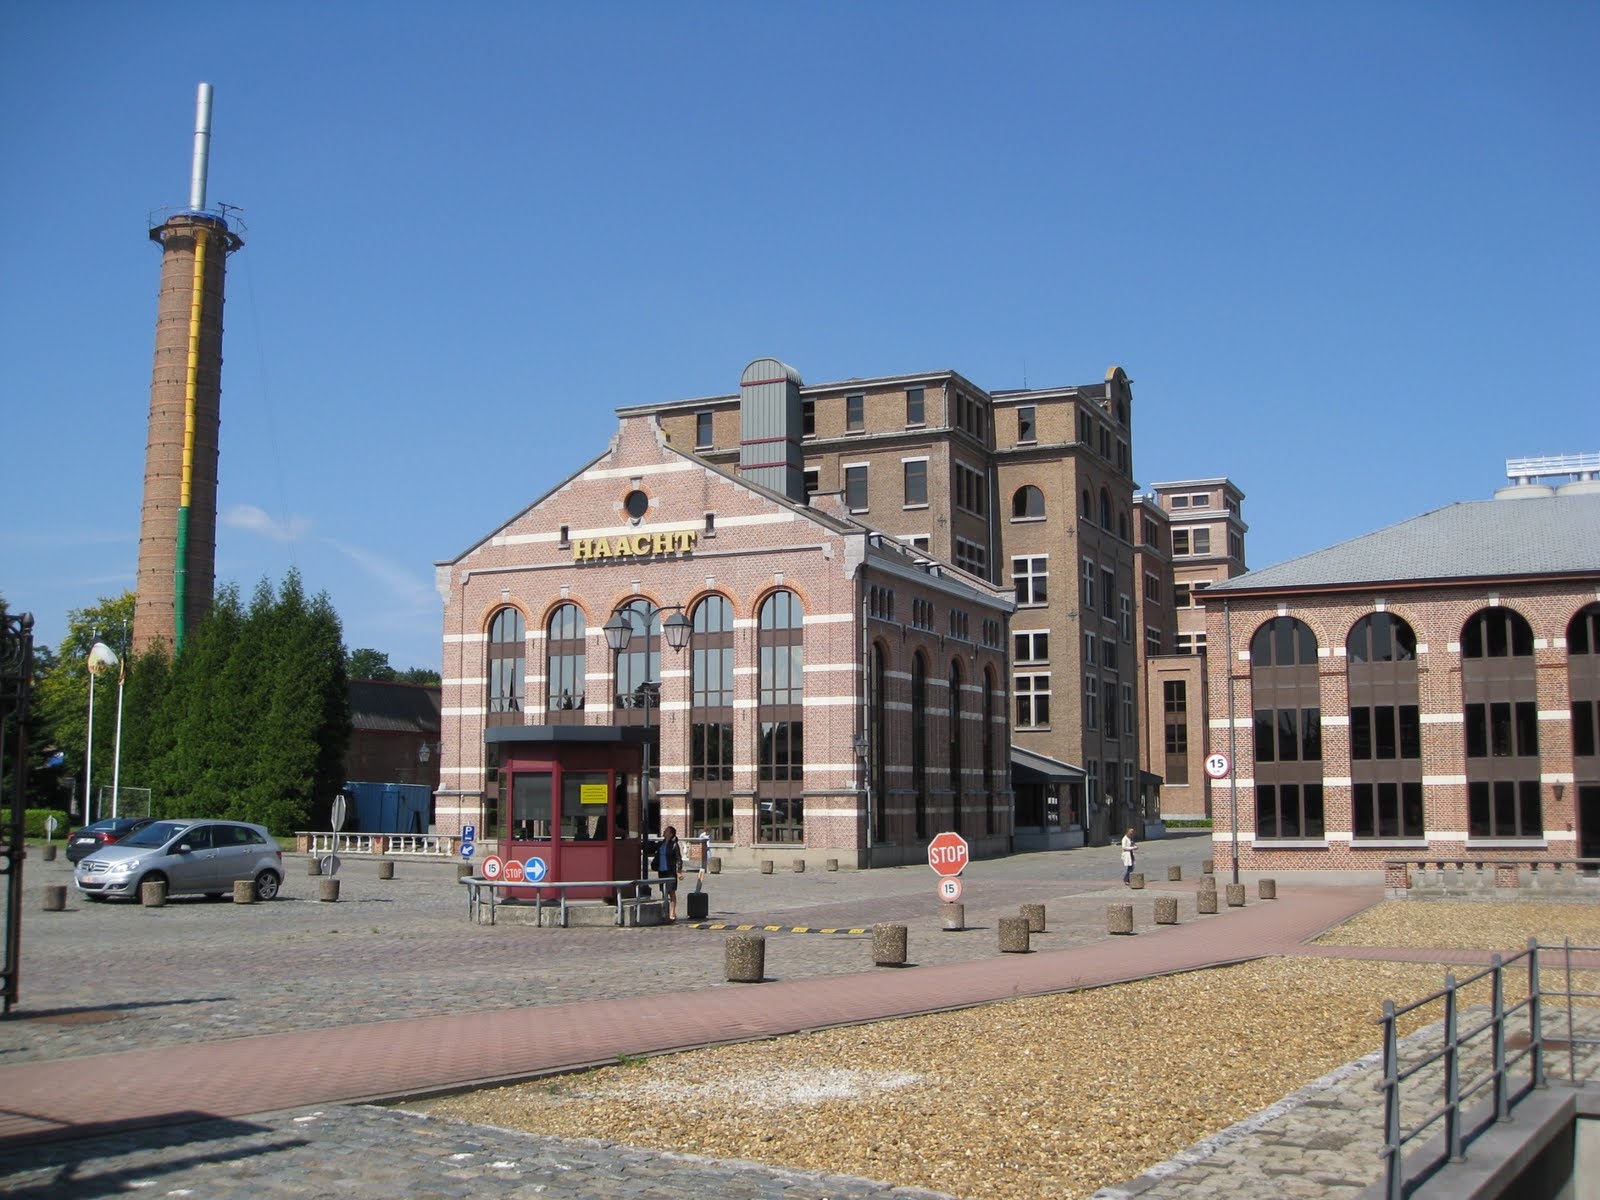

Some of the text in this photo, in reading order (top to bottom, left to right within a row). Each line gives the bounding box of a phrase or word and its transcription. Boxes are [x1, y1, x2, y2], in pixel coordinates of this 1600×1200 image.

[572, 530, 697, 560] HAACHT
[1210, 758, 1224, 769] 15
[931, 845, 966, 864] STOP
[488, 863, 497, 873] 15
[505, 868, 523, 879] STOP
[944, 883, 955, 894] 15
